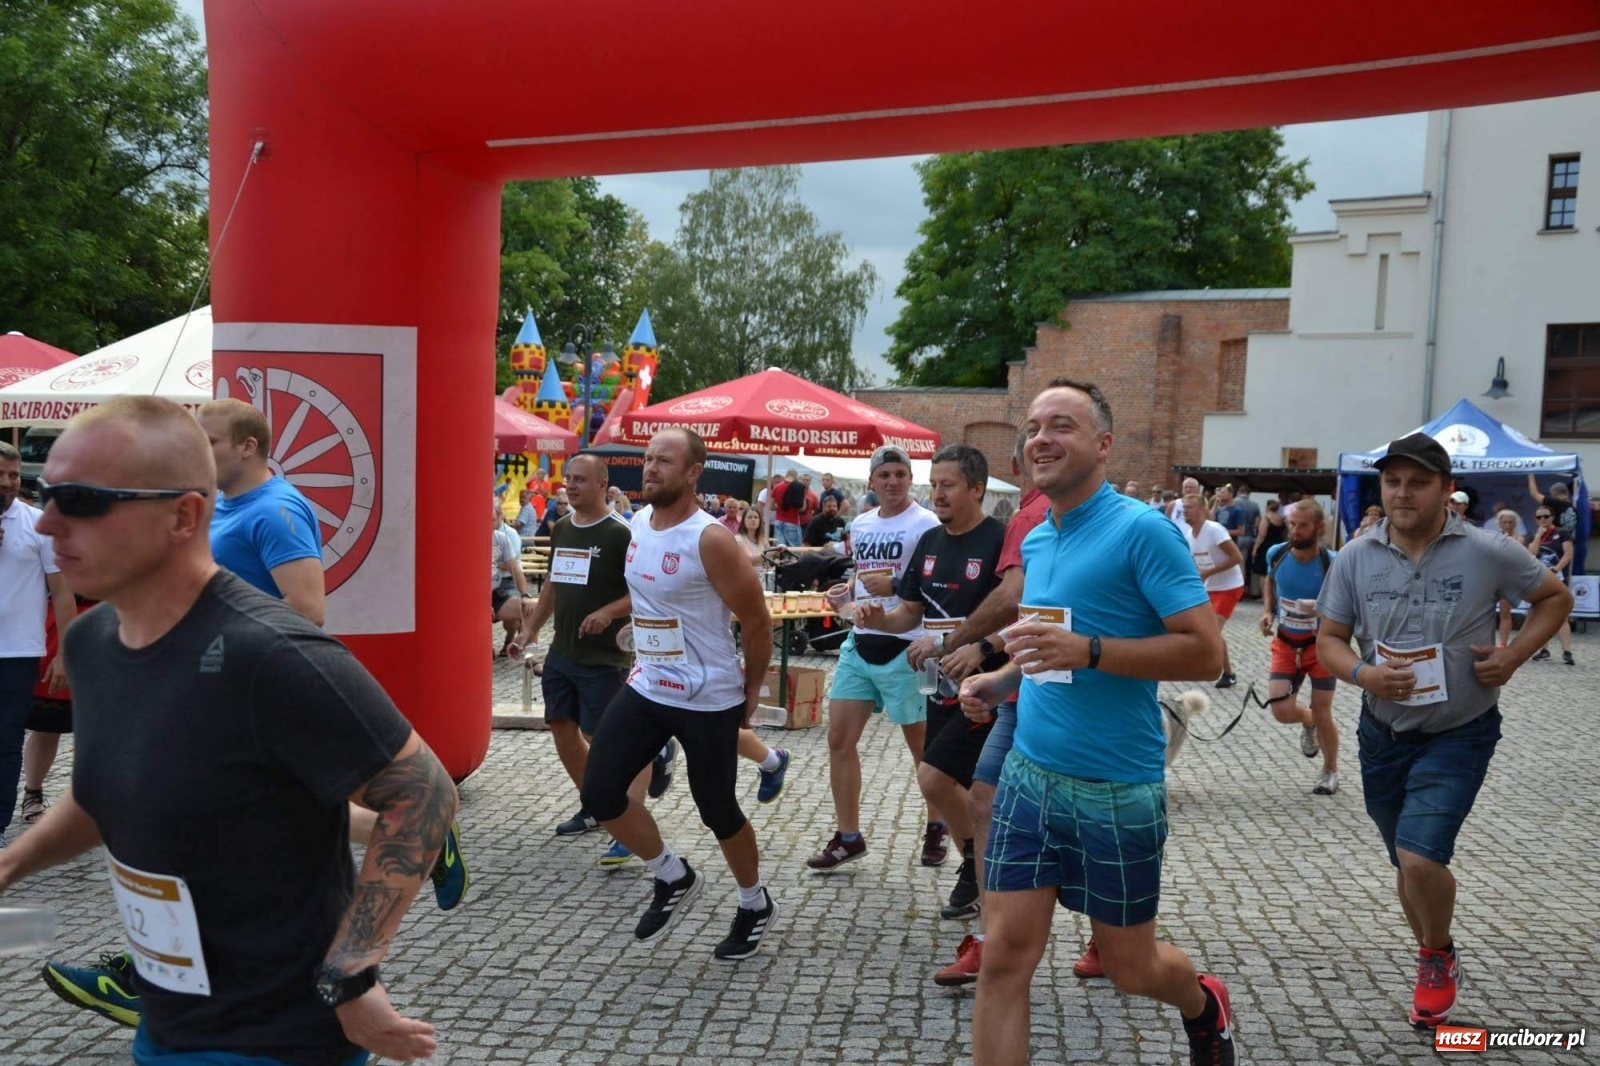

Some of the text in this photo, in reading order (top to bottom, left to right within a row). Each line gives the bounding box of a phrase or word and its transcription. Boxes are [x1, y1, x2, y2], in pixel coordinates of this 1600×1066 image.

[2, 402, 98, 420] RACIBORSK
[750, 424, 858, 445] RACIBORSKIE
[1472, 459, 1546, 470] TERENOWY
[564, 561, 576, 570] 57
[646, 634, 660, 647] 45
